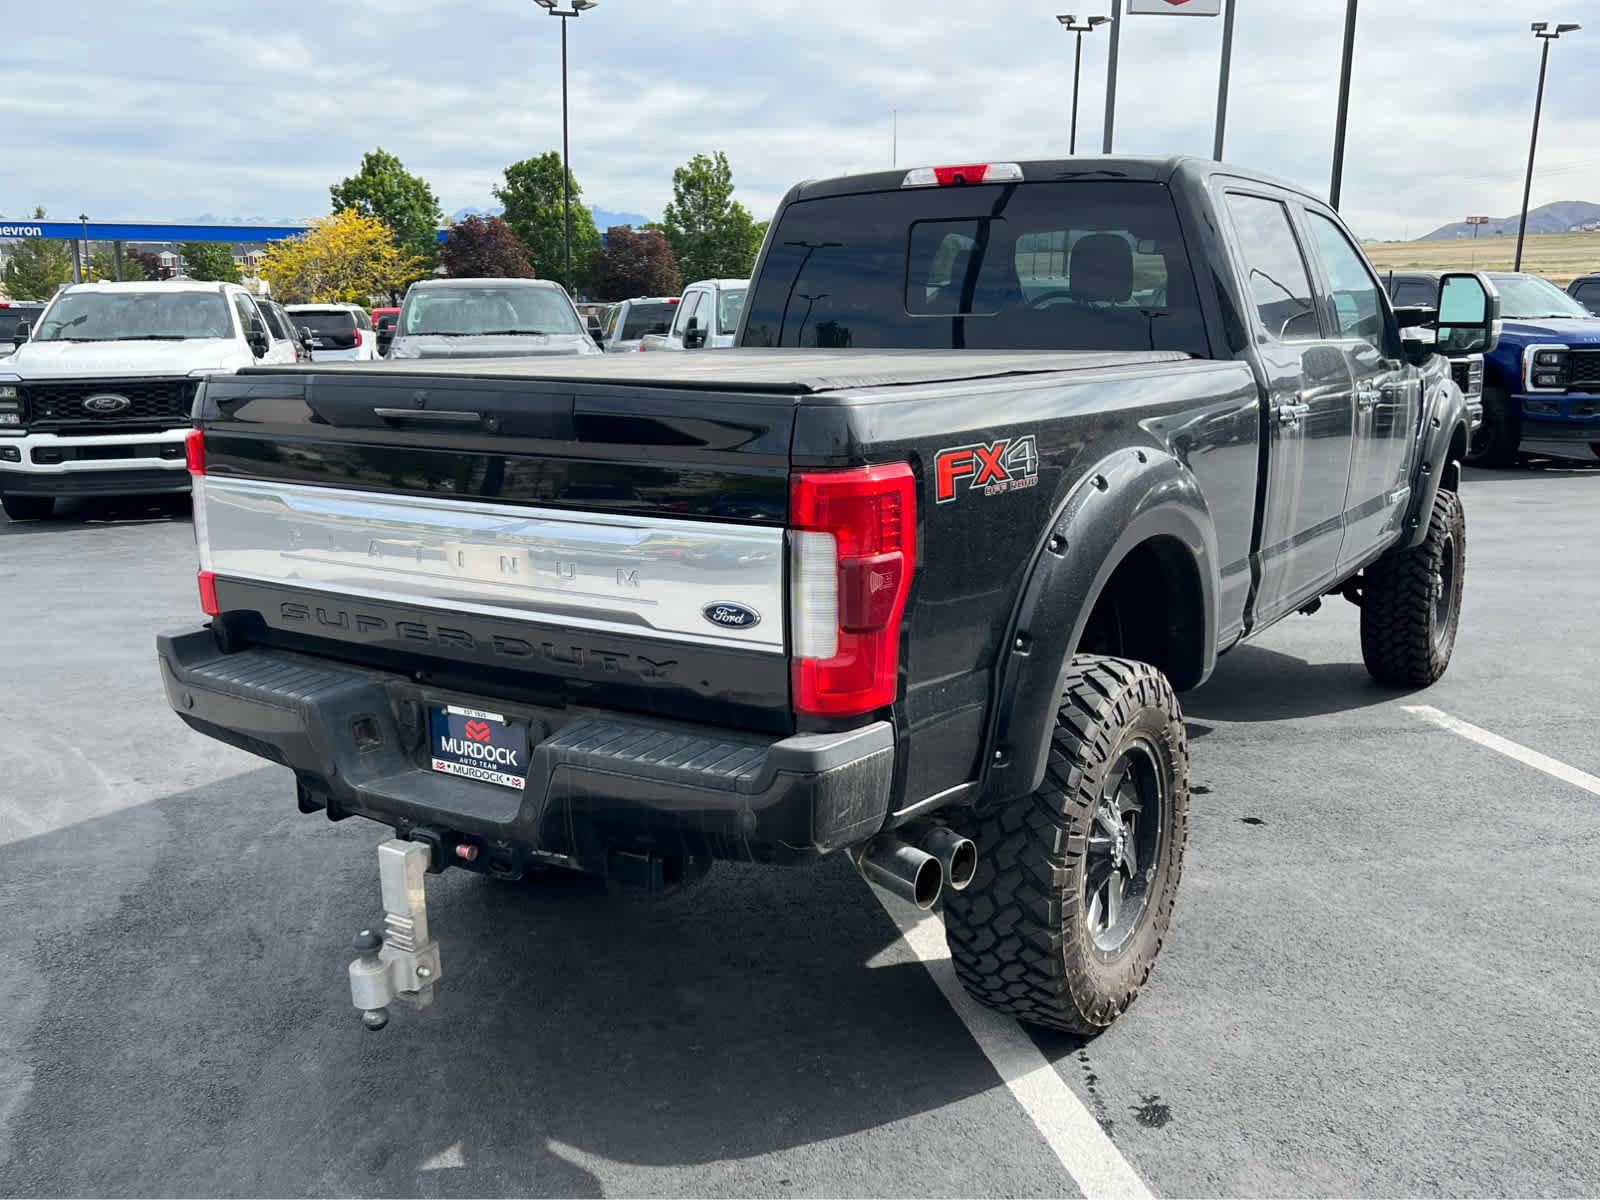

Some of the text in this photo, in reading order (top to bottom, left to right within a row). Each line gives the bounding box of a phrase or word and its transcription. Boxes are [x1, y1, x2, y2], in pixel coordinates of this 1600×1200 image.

[934, 435, 1039, 504] FX4
[288, 527, 640, 589] PLATINUM
[712, 606, 745, 625] Ford
[279, 601, 679, 679] SUPER DUTY
[441, 735, 518, 767] MURDOCK
[460, 757, 497, 770] AUTO TEAM
[453, 765, 504, 784] MURDOCK
